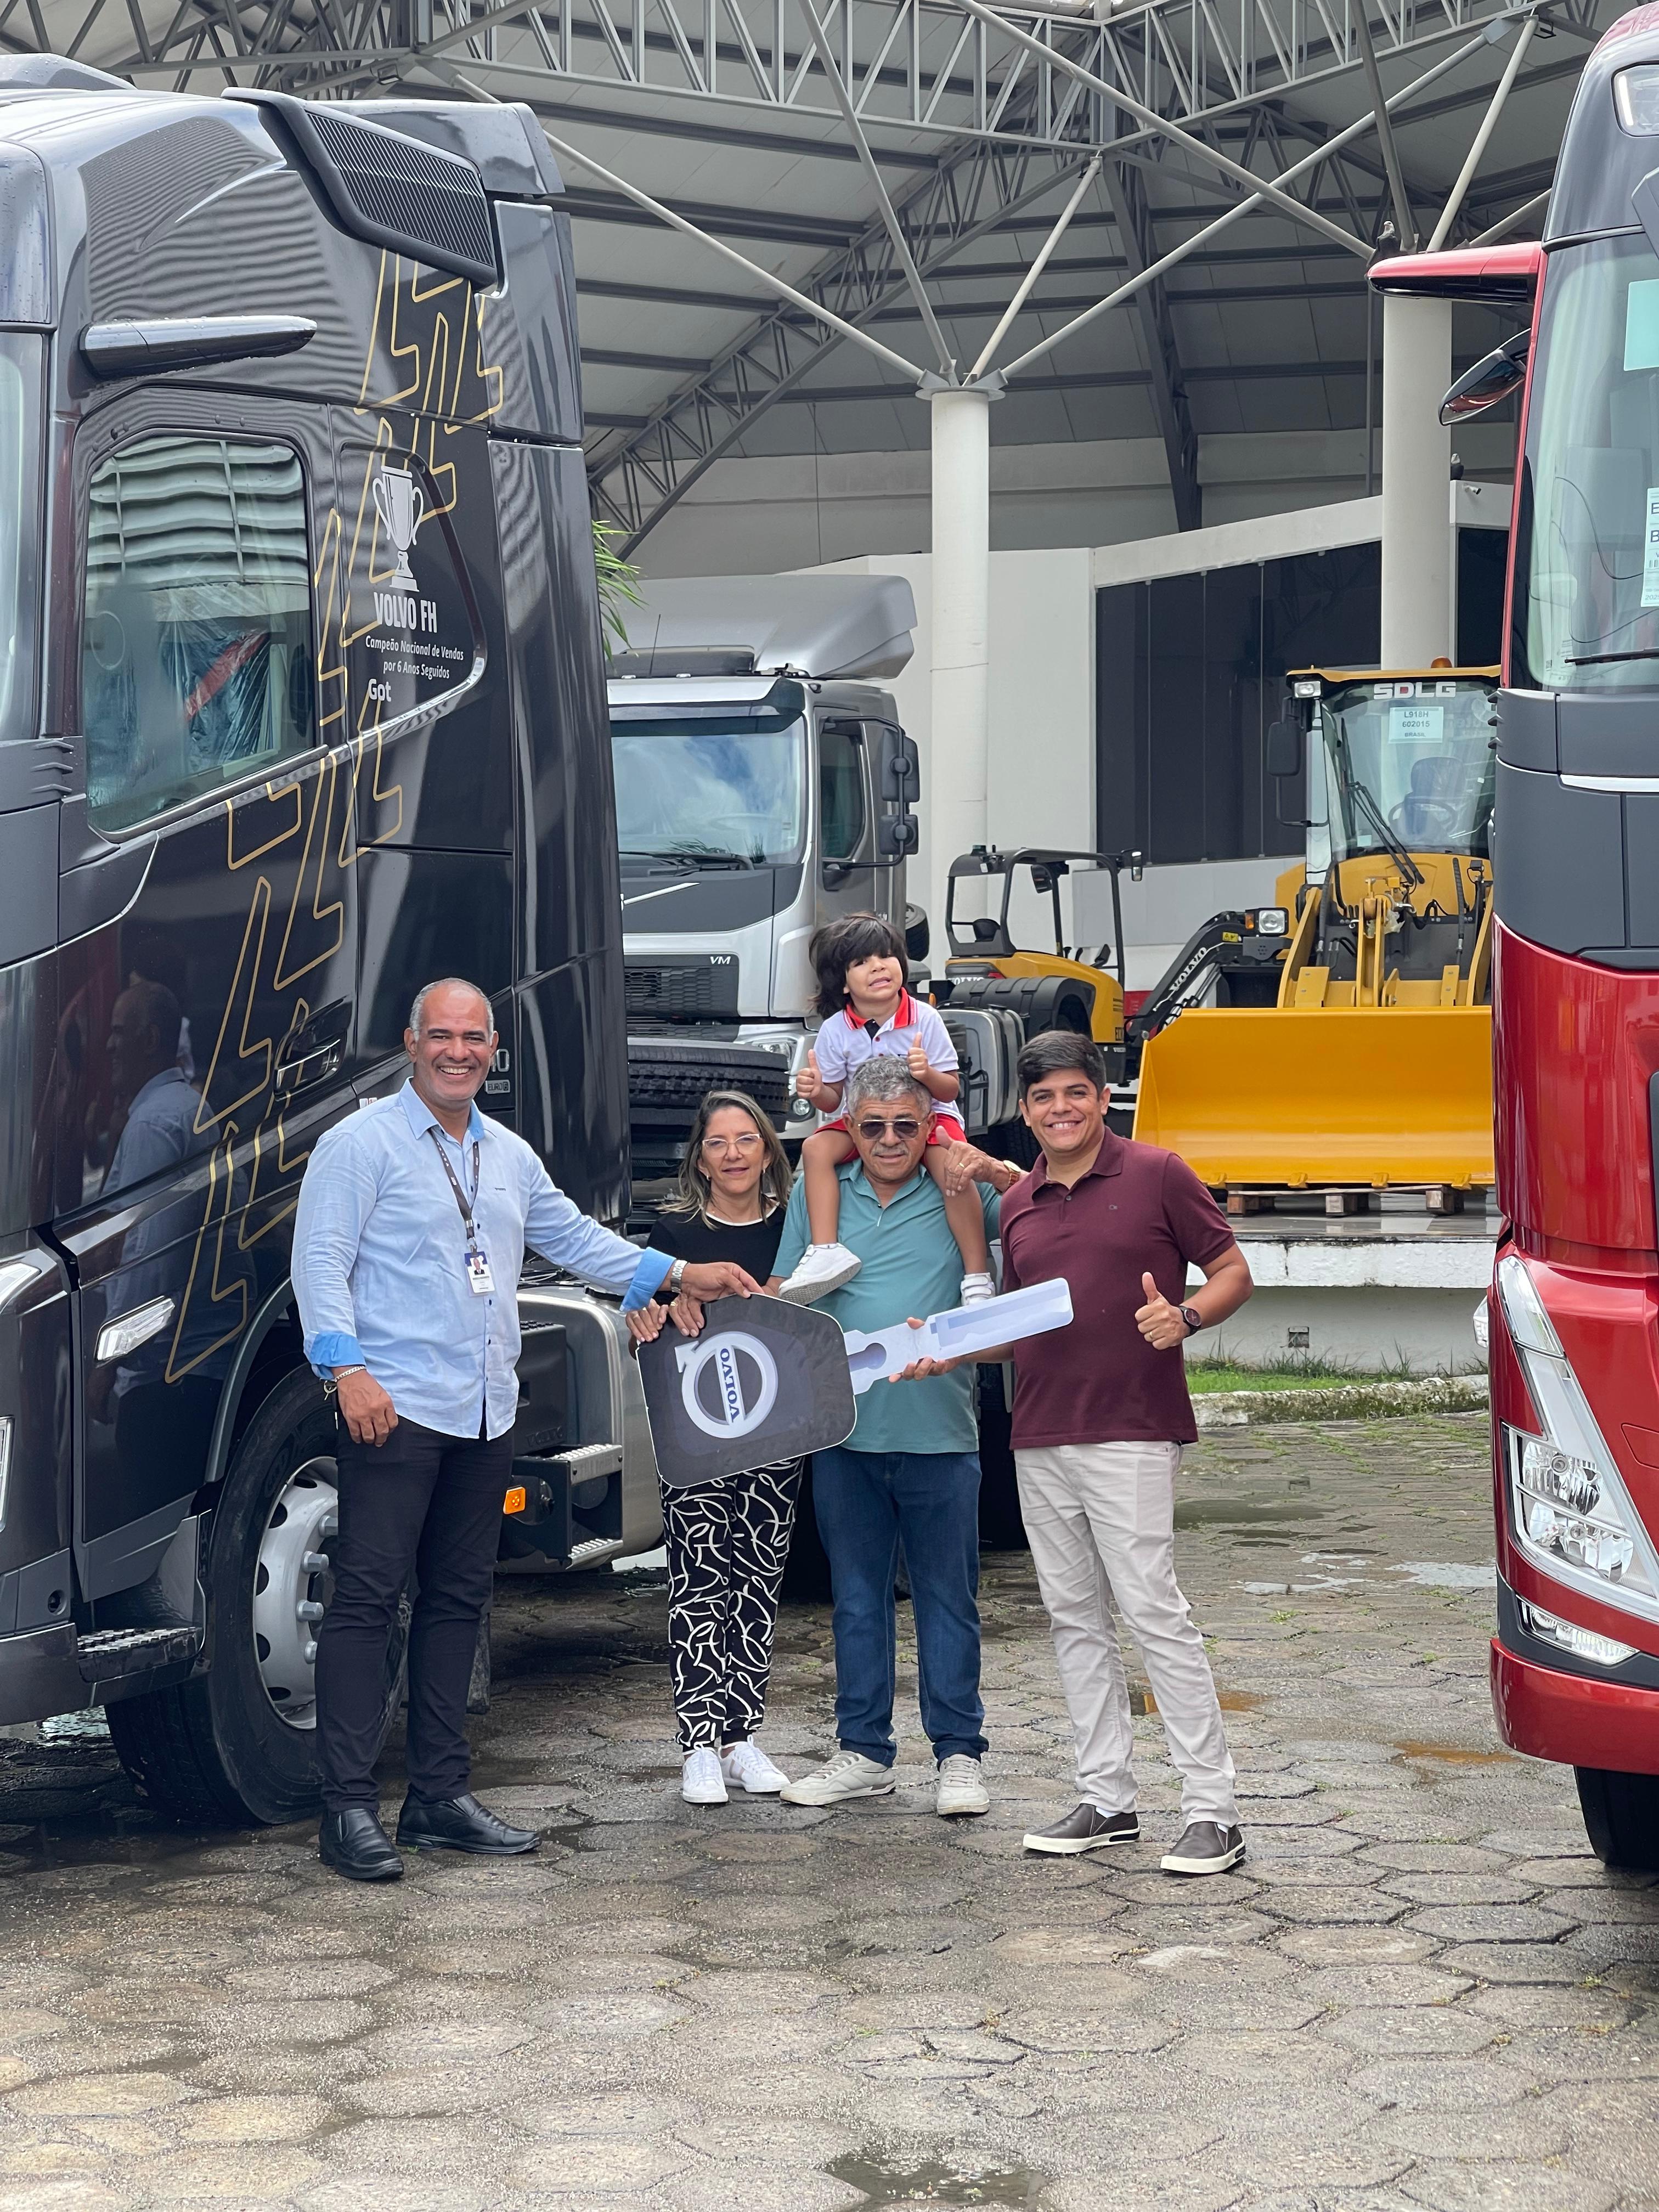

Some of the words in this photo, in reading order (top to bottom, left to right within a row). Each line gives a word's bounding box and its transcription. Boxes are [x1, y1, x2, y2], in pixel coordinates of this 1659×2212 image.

[374, 592, 416, 630] VOLVO
[420, 600, 437, 633] FH
[365, 635, 399, 652] Campeão
[400, 640, 431, 657] Nacional
[432, 646, 440, 658] de
[441, 647, 464, 661] Vendas
[383, 662, 396, 674] por
[397, 661, 402, 672] 6
[403, 662, 420, 675] Anos
[421, 664, 450, 680] Seguidos
[368, 679, 392, 702] Got
[1374, 681, 1456, 699] SDLG
[710, 956, 731, 964] VM
[1169, 947, 1207, 991] VOLVO
[720, 1348, 740, 1423] VOLVO
